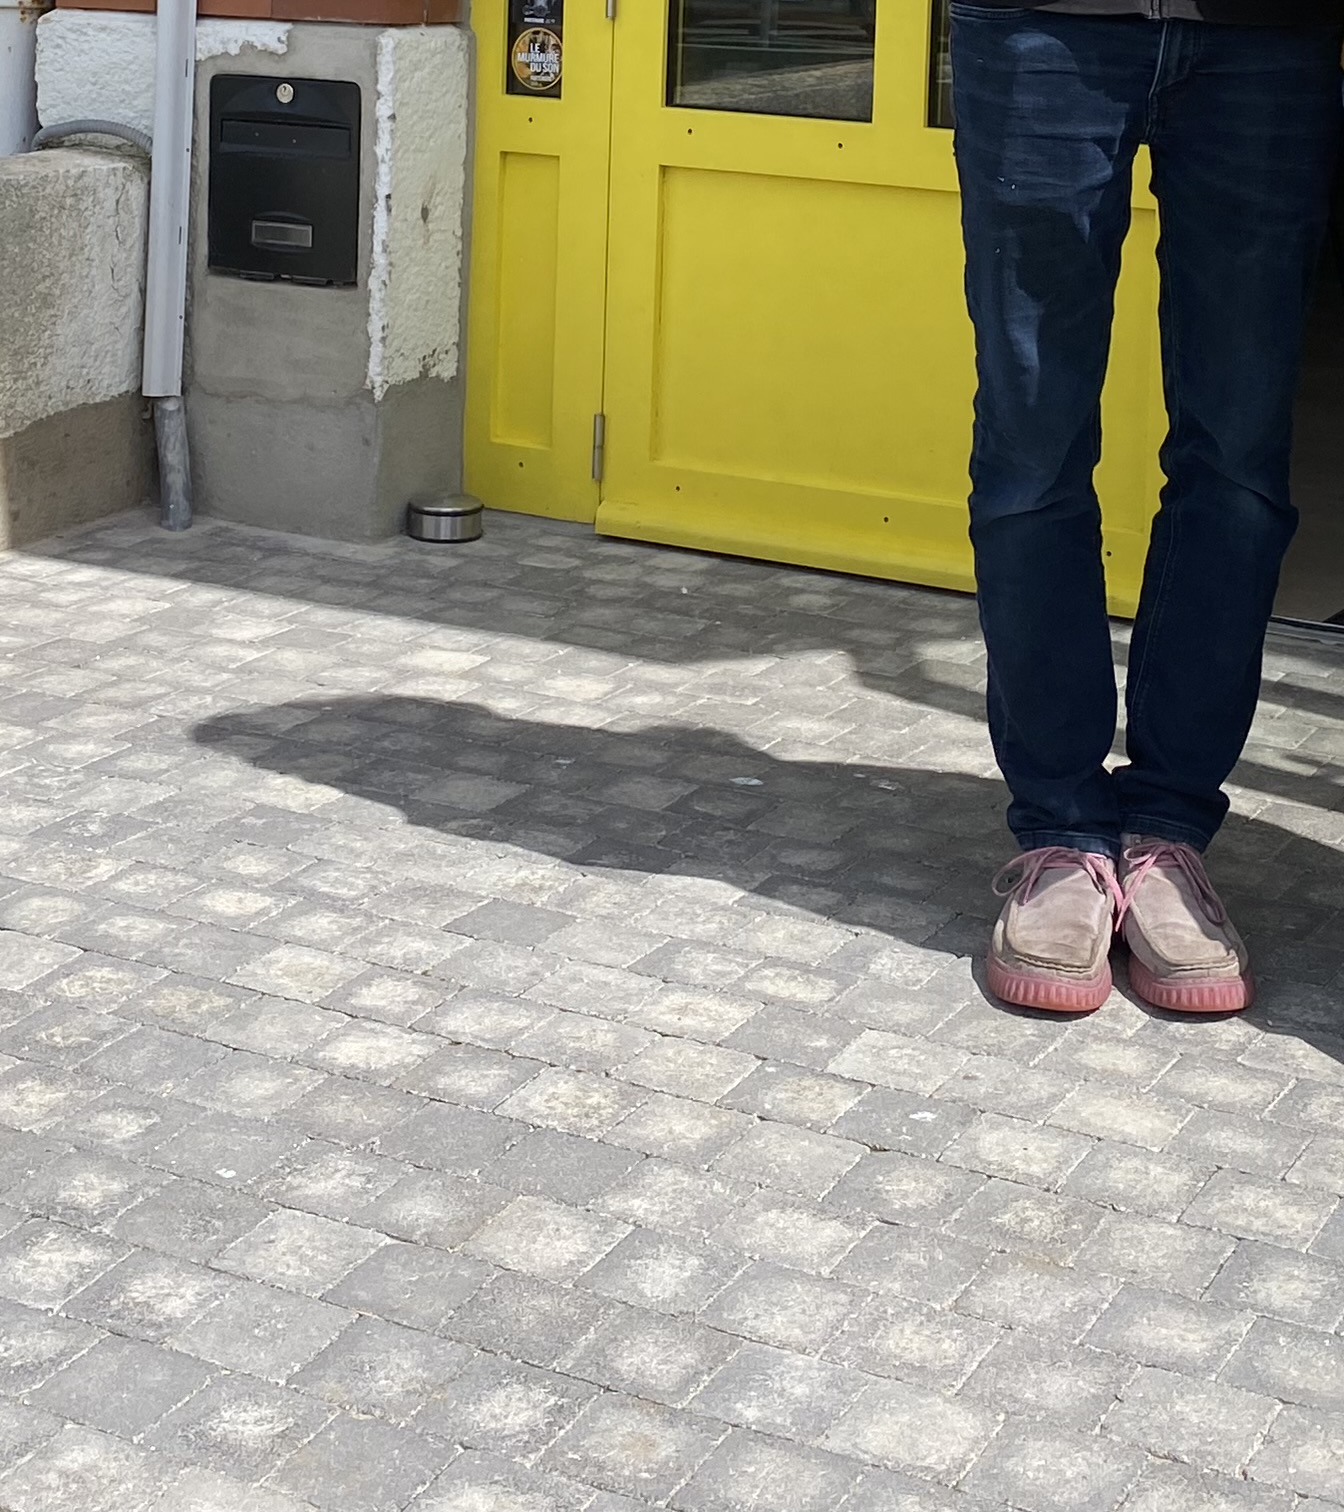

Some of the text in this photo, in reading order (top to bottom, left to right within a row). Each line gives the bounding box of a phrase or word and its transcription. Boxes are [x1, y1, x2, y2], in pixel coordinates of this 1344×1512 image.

[530, 43, 541, 53] LE
[517, 52, 560, 64] MURMURE
[530, 62, 560, 73] DU SON
